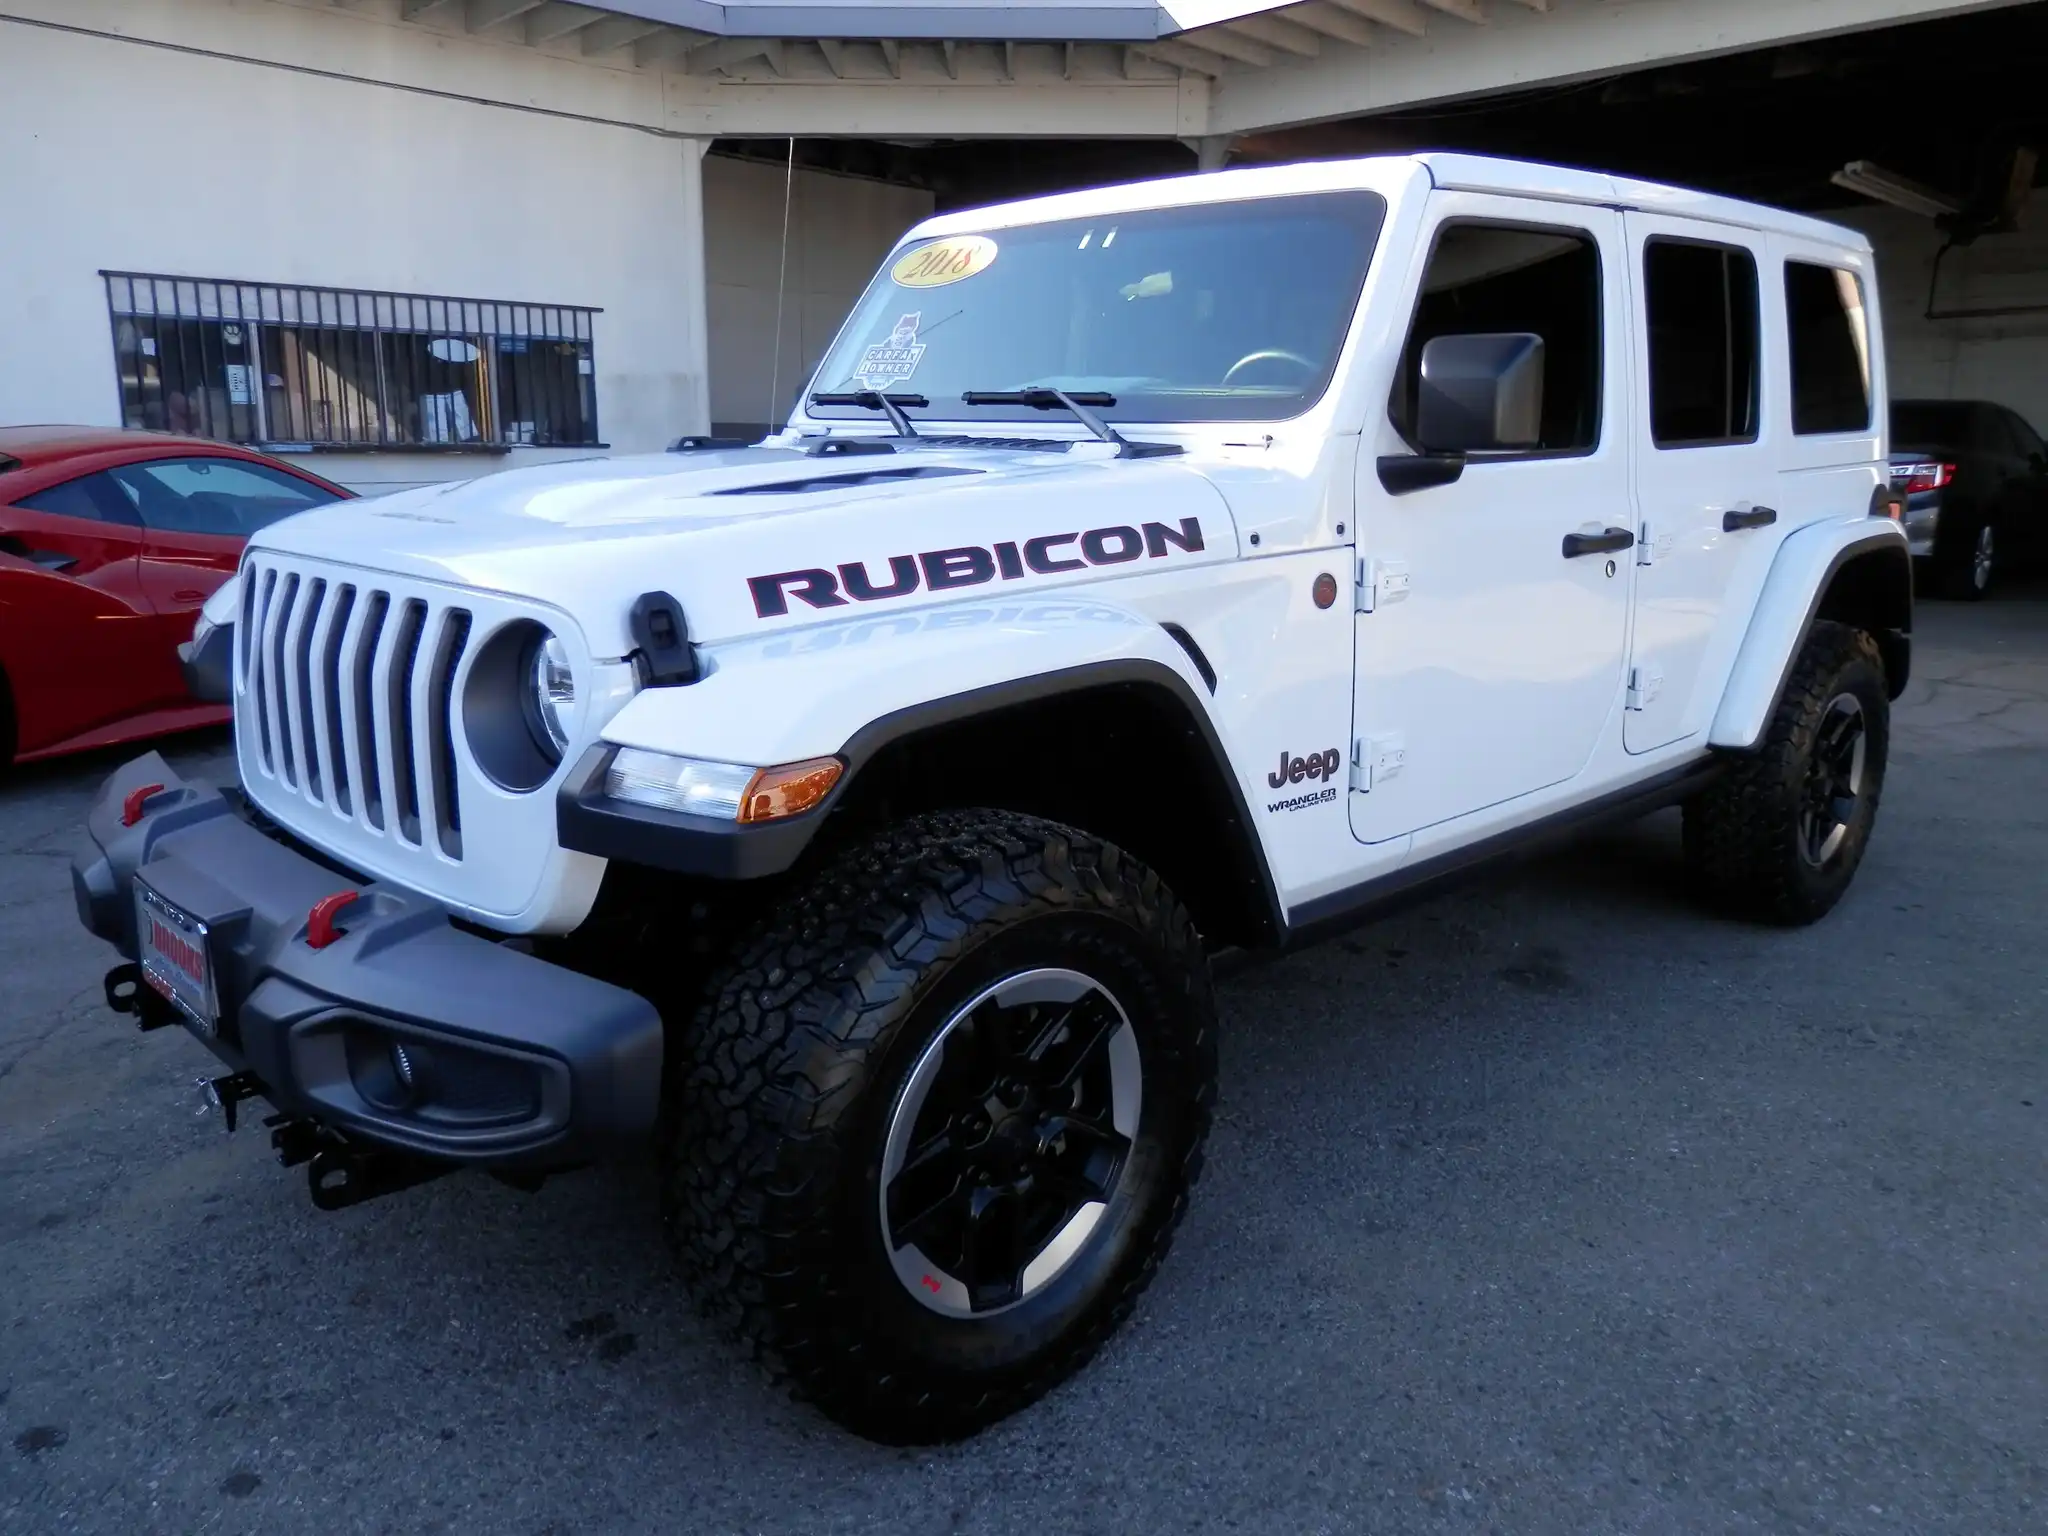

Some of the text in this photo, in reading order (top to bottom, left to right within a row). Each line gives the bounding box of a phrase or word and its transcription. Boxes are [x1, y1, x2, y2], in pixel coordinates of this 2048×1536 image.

[902, 245, 982, 280] 2018
[868, 350, 920, 361] CARFAX
[870, 363, 911, 373] OWNER
[746, 517, 1205, 619] RUBICON
[1268, 748, 1340, 789] Jeep
[1267, 788, 1337, 813] WRANGLER
[1289, 796, 1337, 812] UNLIMITED
